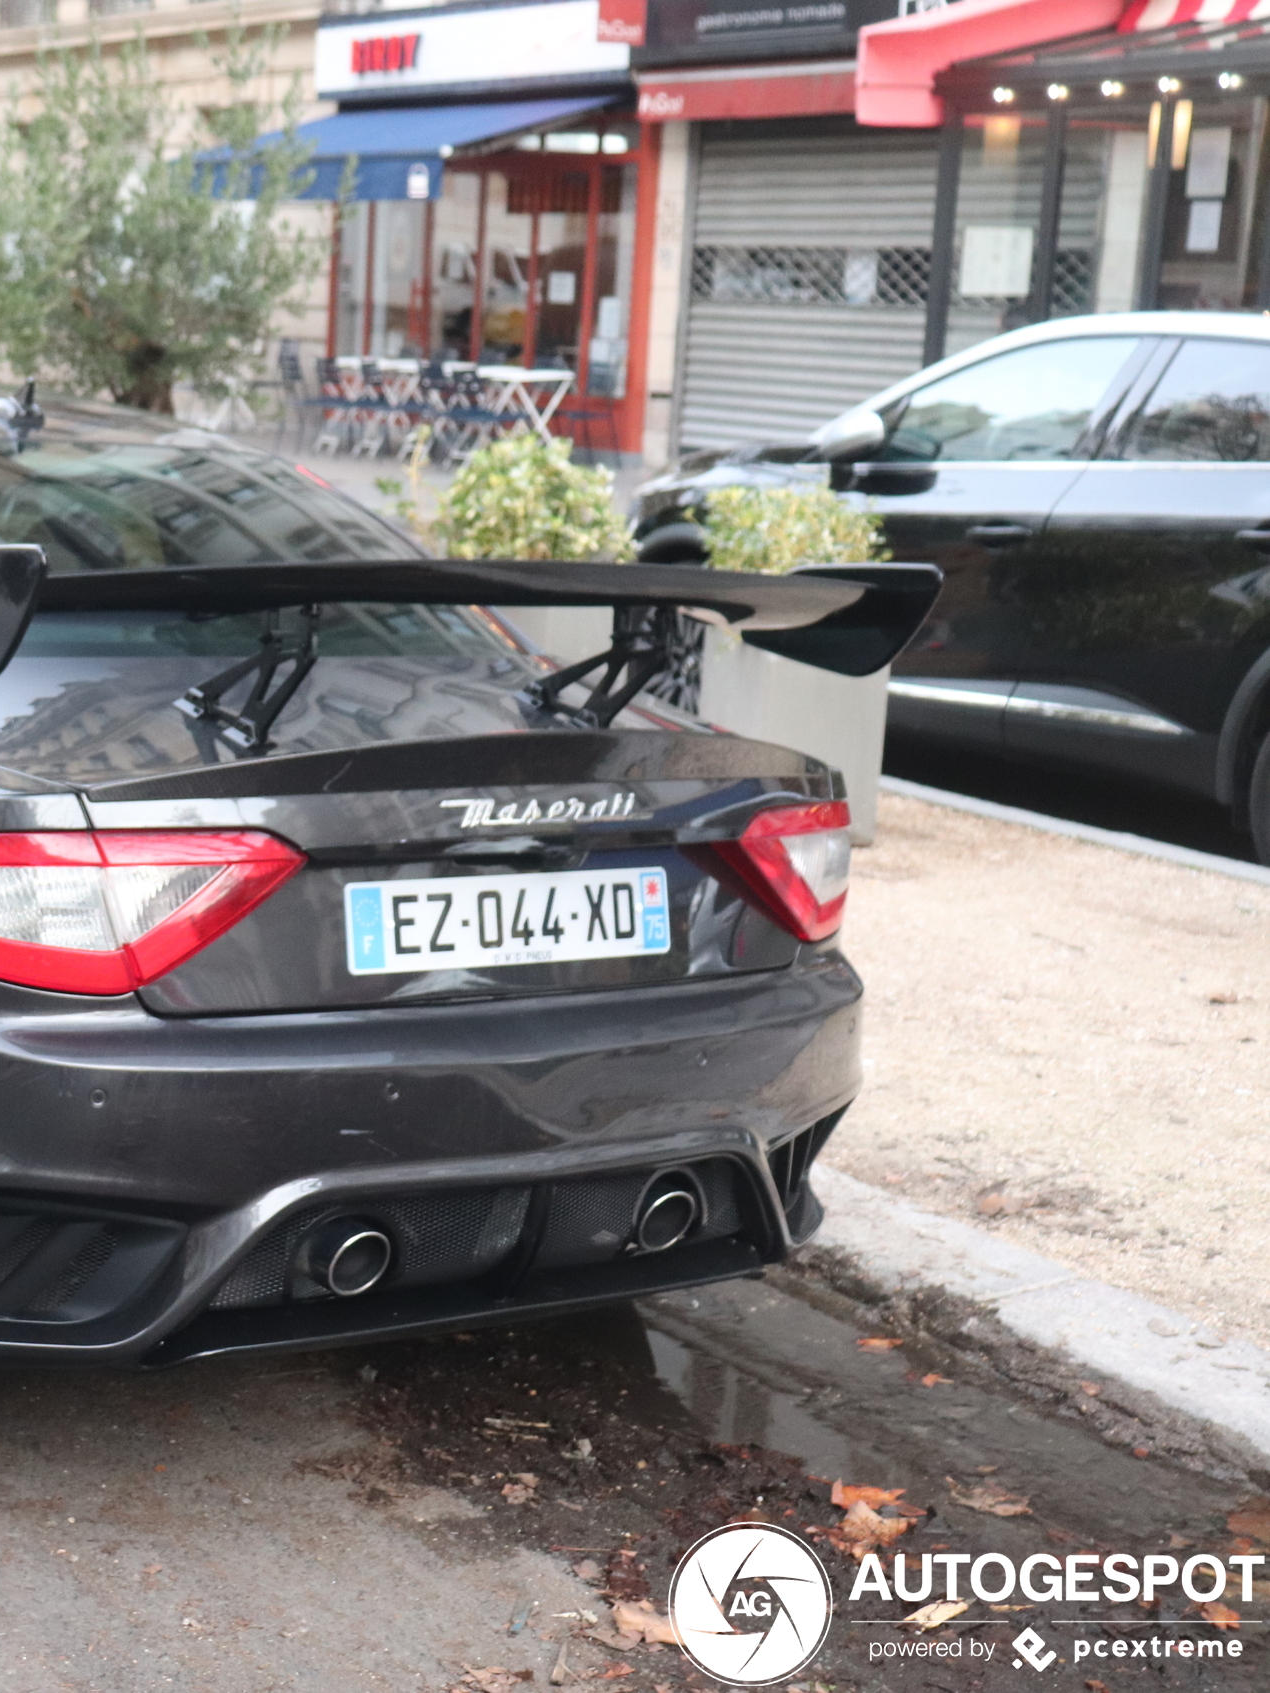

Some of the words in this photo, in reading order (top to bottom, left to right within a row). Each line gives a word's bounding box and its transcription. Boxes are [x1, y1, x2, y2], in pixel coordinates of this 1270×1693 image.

[439, 792, 638, 829] Maserati
[645, 914, 665, 940] 75
[363, 935, 375, 955] F
